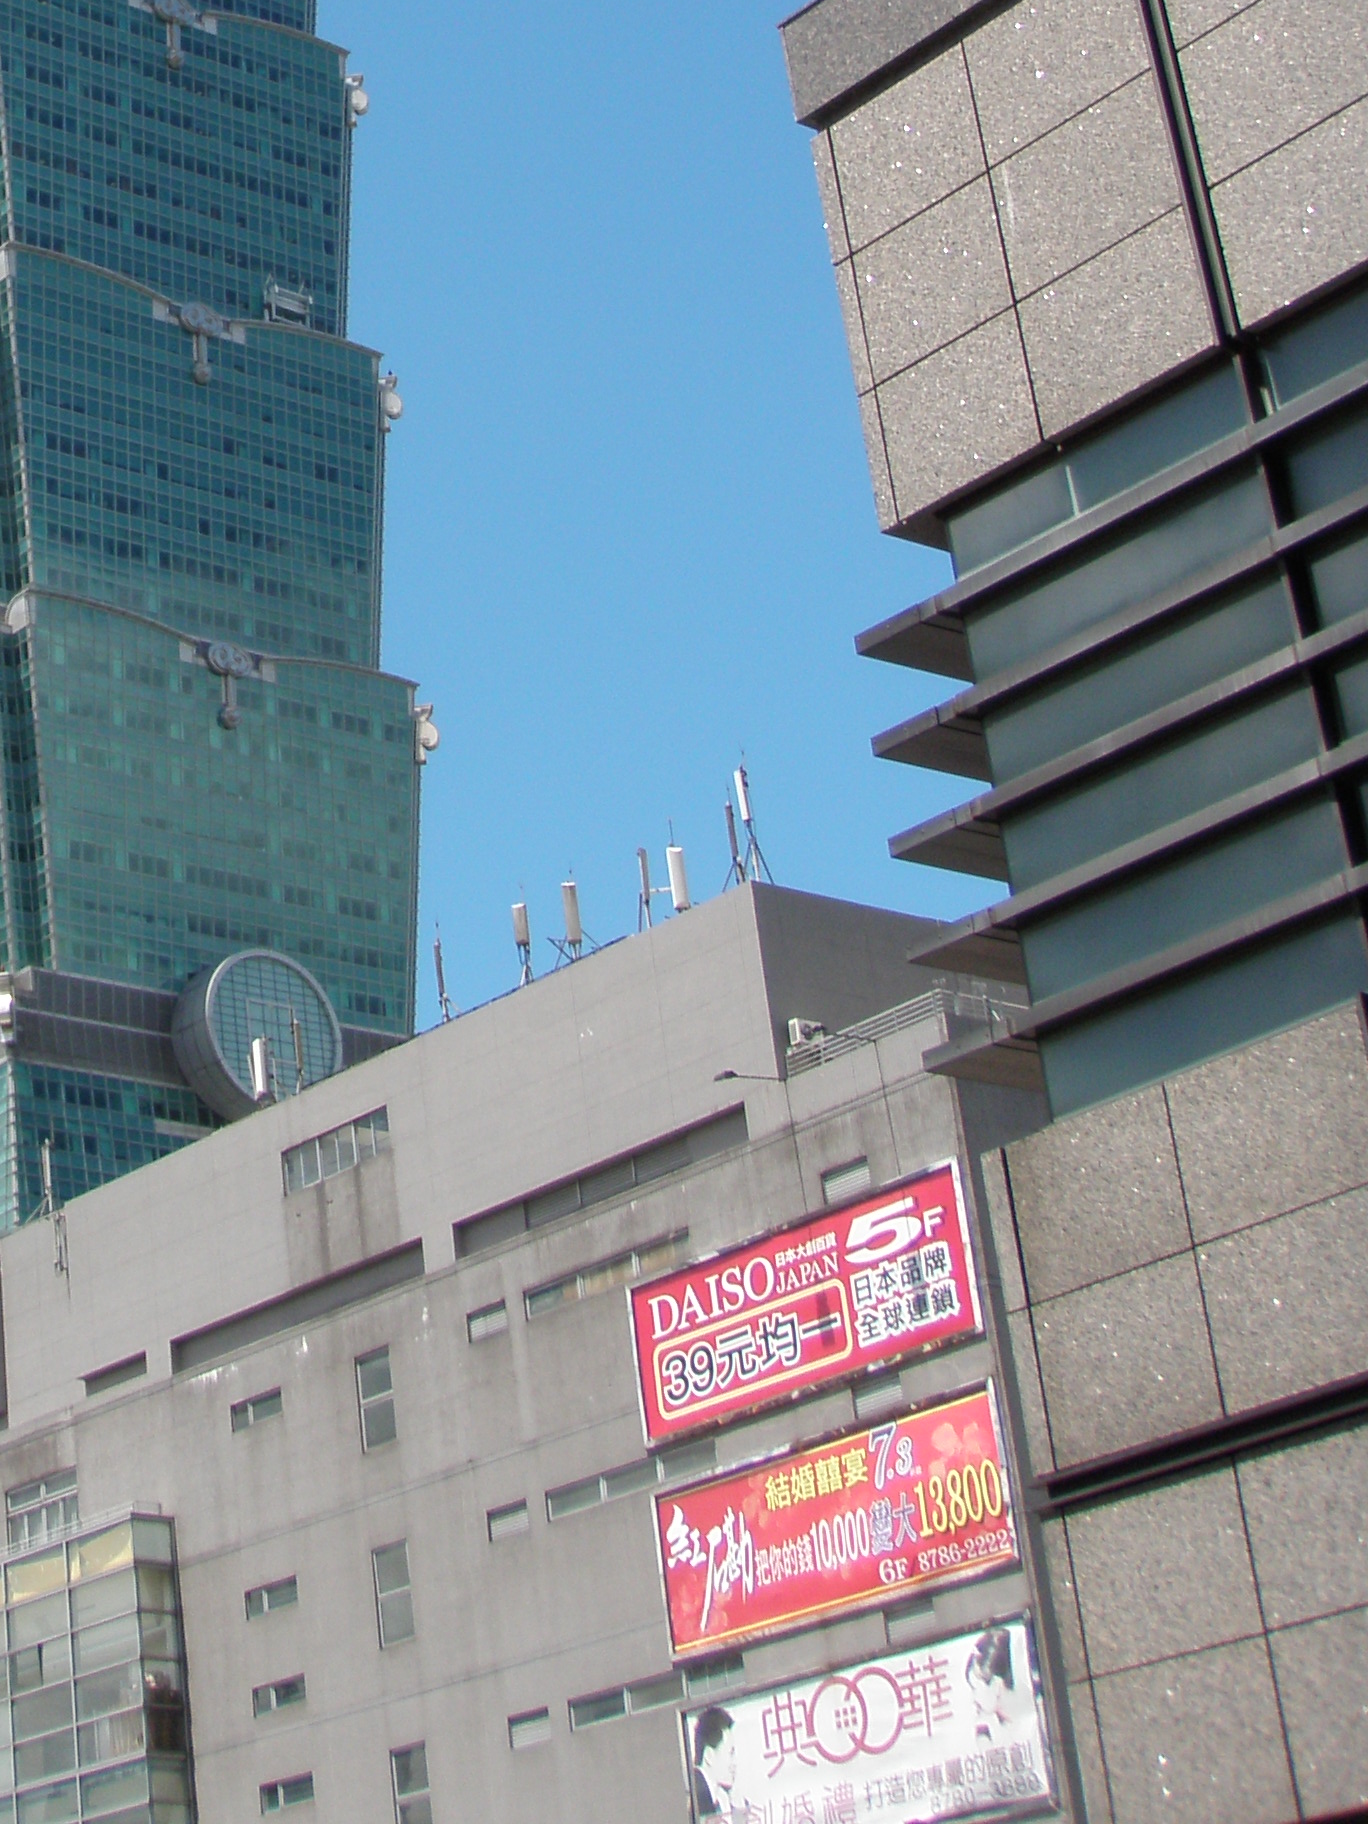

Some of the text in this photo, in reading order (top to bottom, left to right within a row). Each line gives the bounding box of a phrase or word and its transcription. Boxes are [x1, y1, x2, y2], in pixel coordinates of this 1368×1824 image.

[647, 1256, 774, 1339] DAISO
[775, 1251, 839, 1294] JAPAN
[850, 1240, 952, 1310] 日本品牌
[854, 1278, 960, 1348] 全球連鎖
[662, 1312, 841, 1405] 39元均一
[917, 1528, 1012, 1573] 8786-2222
